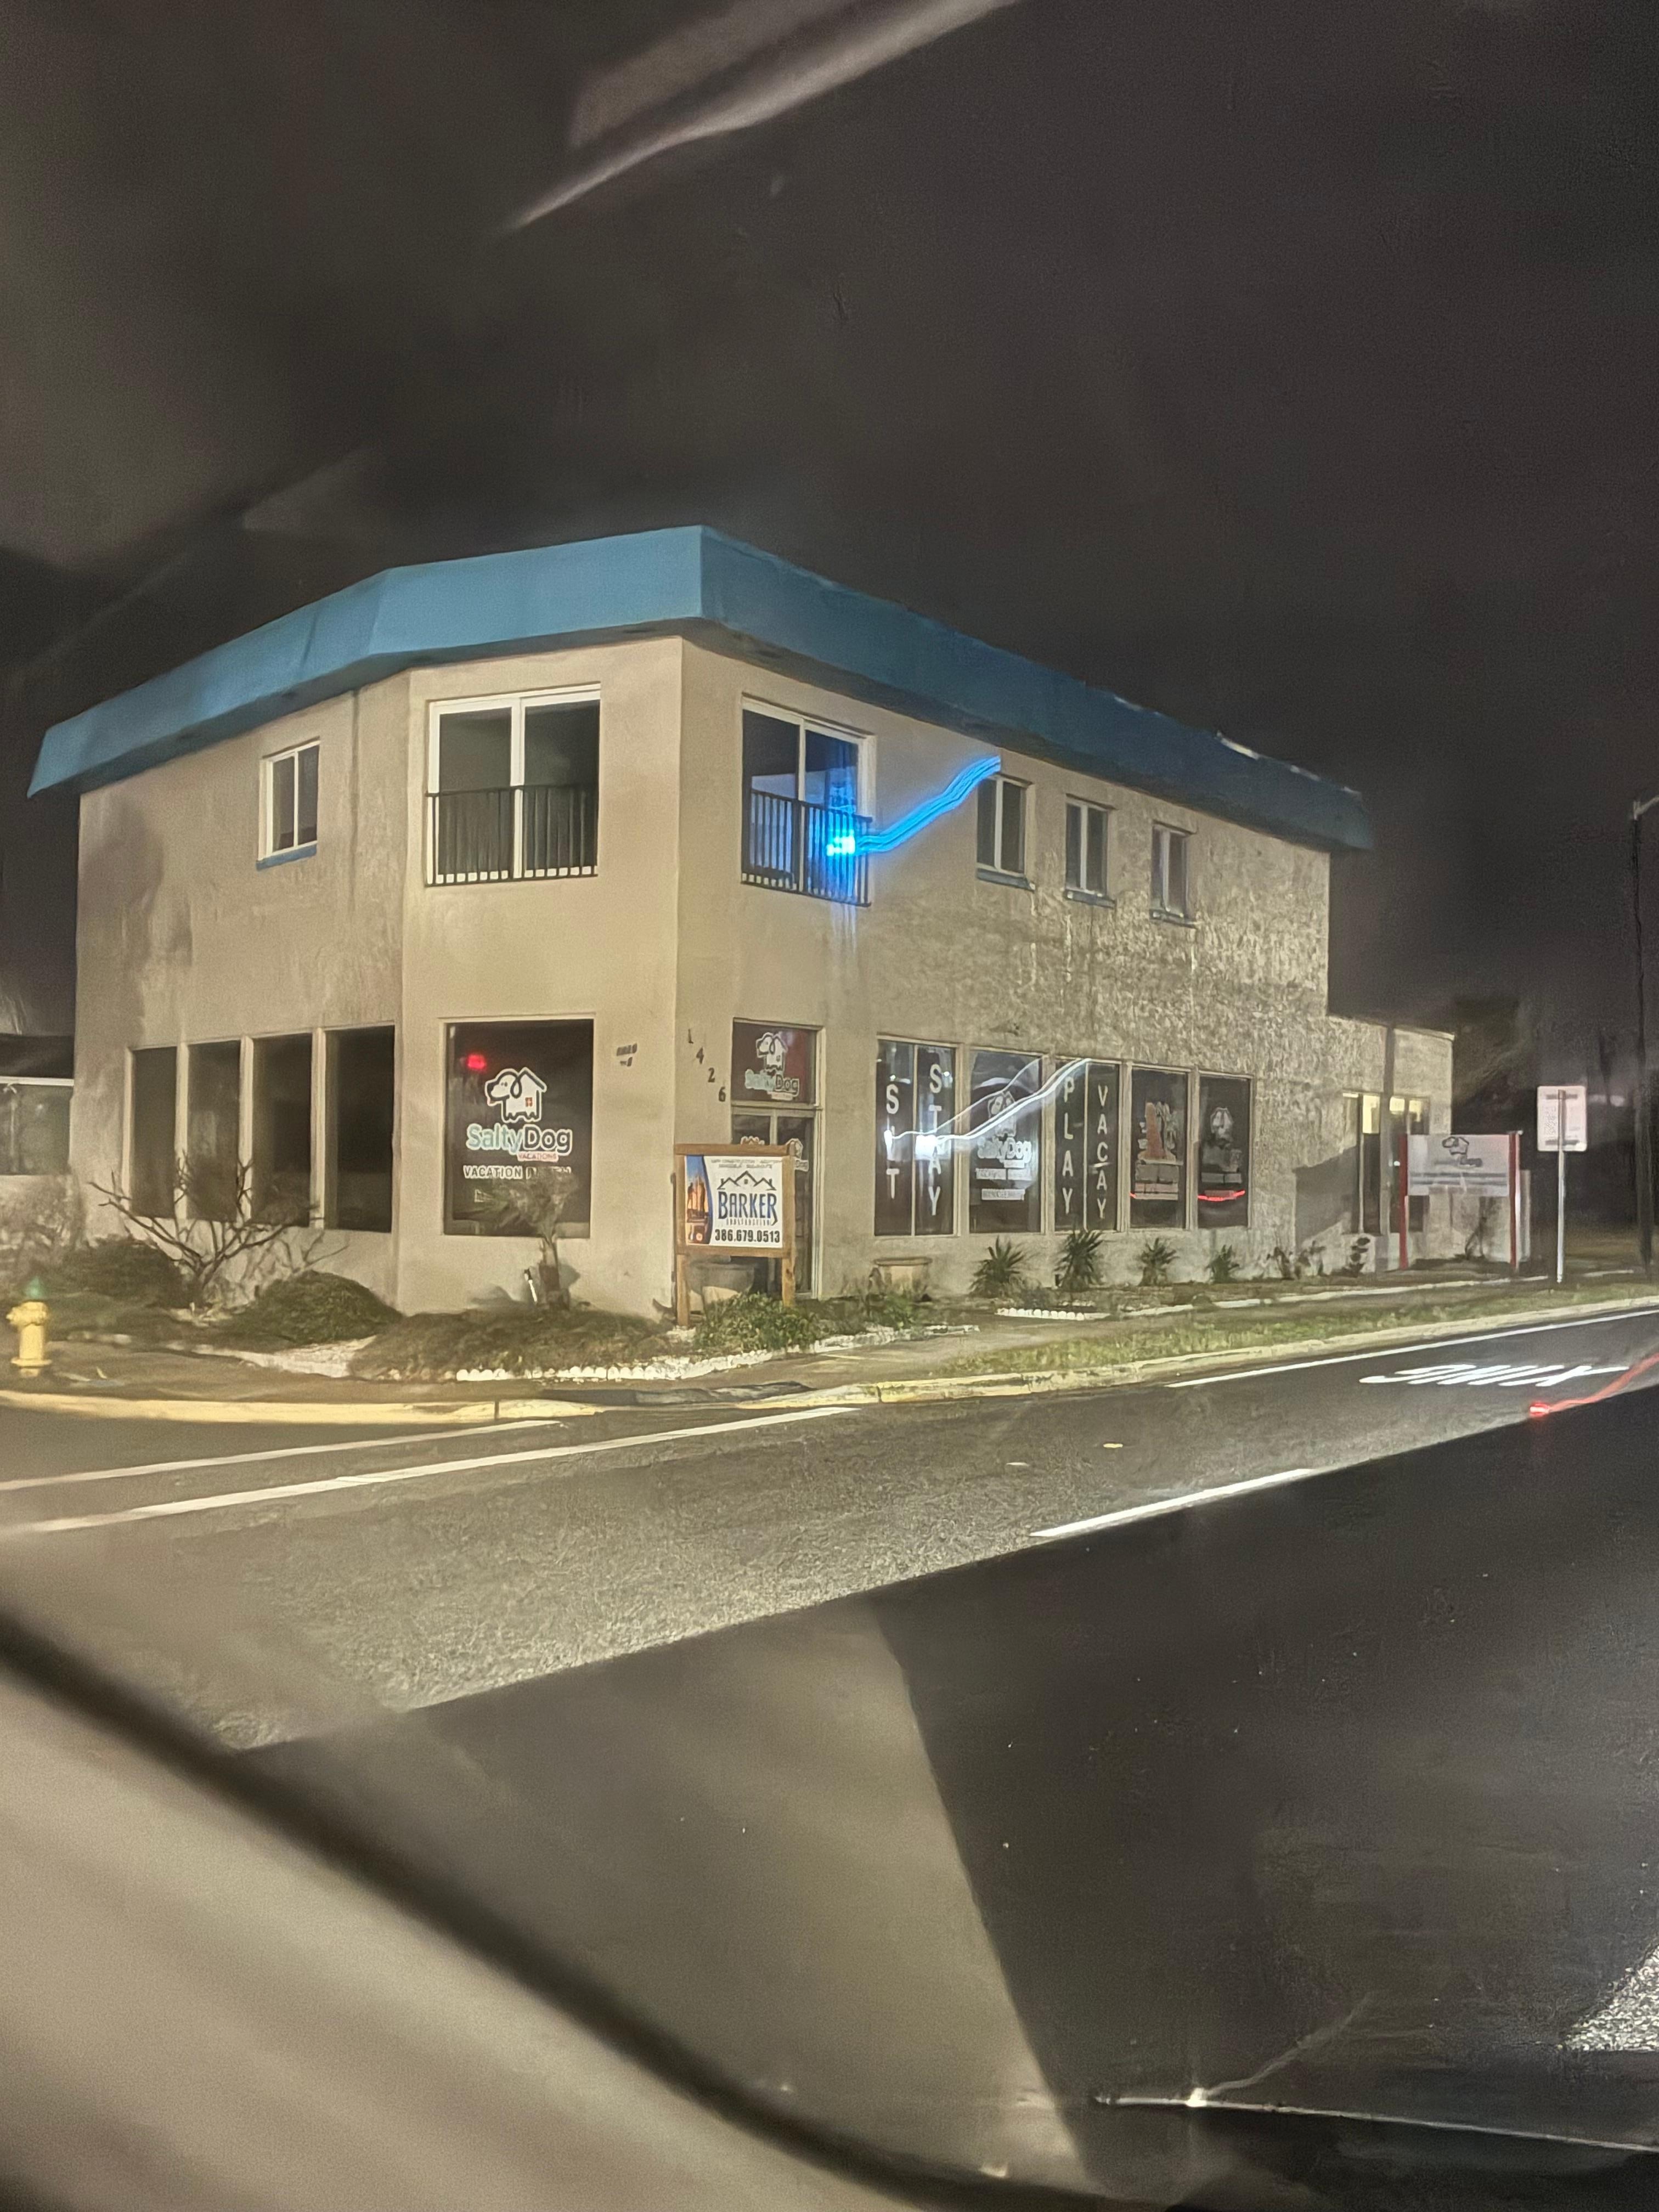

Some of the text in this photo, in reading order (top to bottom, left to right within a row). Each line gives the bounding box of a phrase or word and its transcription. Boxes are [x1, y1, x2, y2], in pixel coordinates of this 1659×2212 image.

[1062, 1076, 1075, 1215] PLAY
[1097, 1084, 1108, 1220] VACAY
[464, 1166, 523, 1179] VACATION
[718, 1191, 777, 1226] BARKER
[715, 1229, 780, 1243] 386.679.0513
